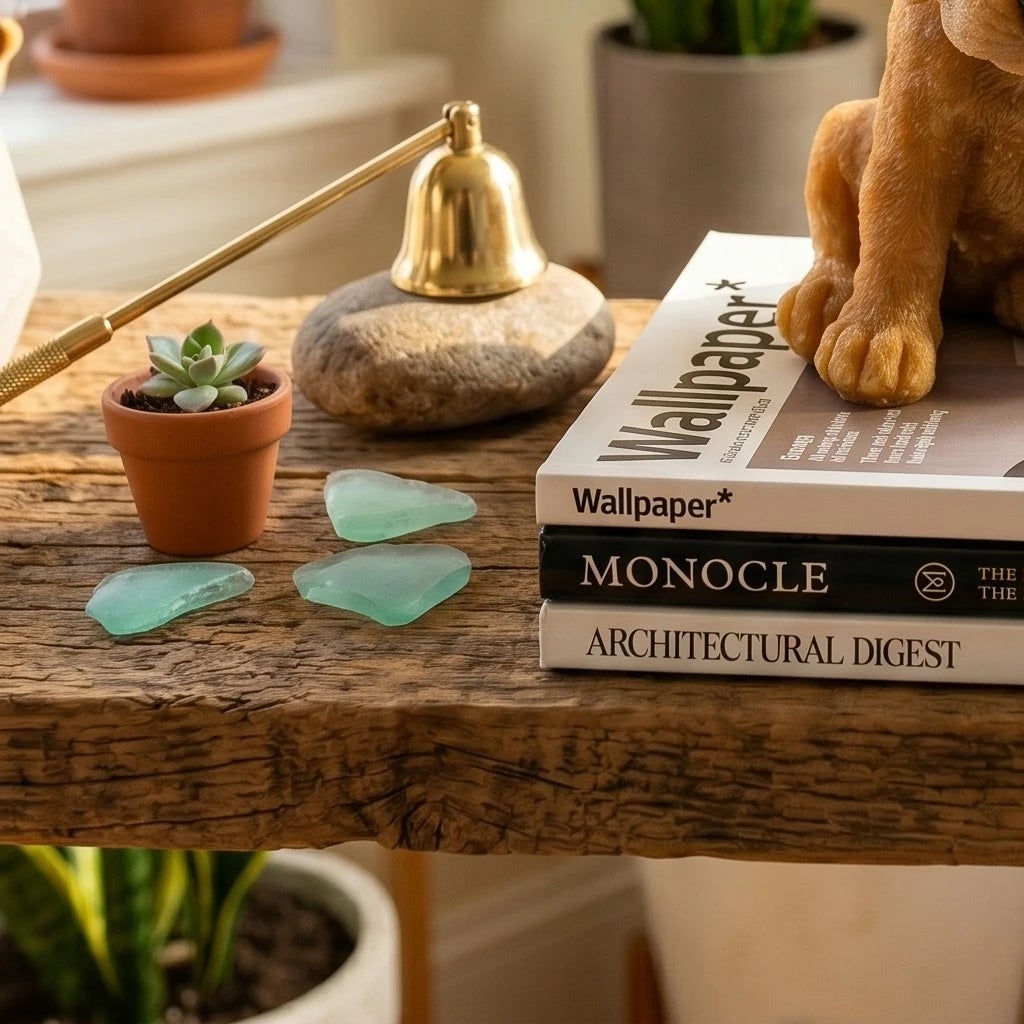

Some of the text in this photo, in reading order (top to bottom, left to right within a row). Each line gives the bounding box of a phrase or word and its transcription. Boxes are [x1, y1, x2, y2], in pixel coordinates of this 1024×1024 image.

[580, 555, 829, 593] MONOCLE
[978, 567, 1017, 581] THE
[978, 586, 1017, 600] THE
[585, 626, 961, 669] ARCHITECTURAL DIGEST
